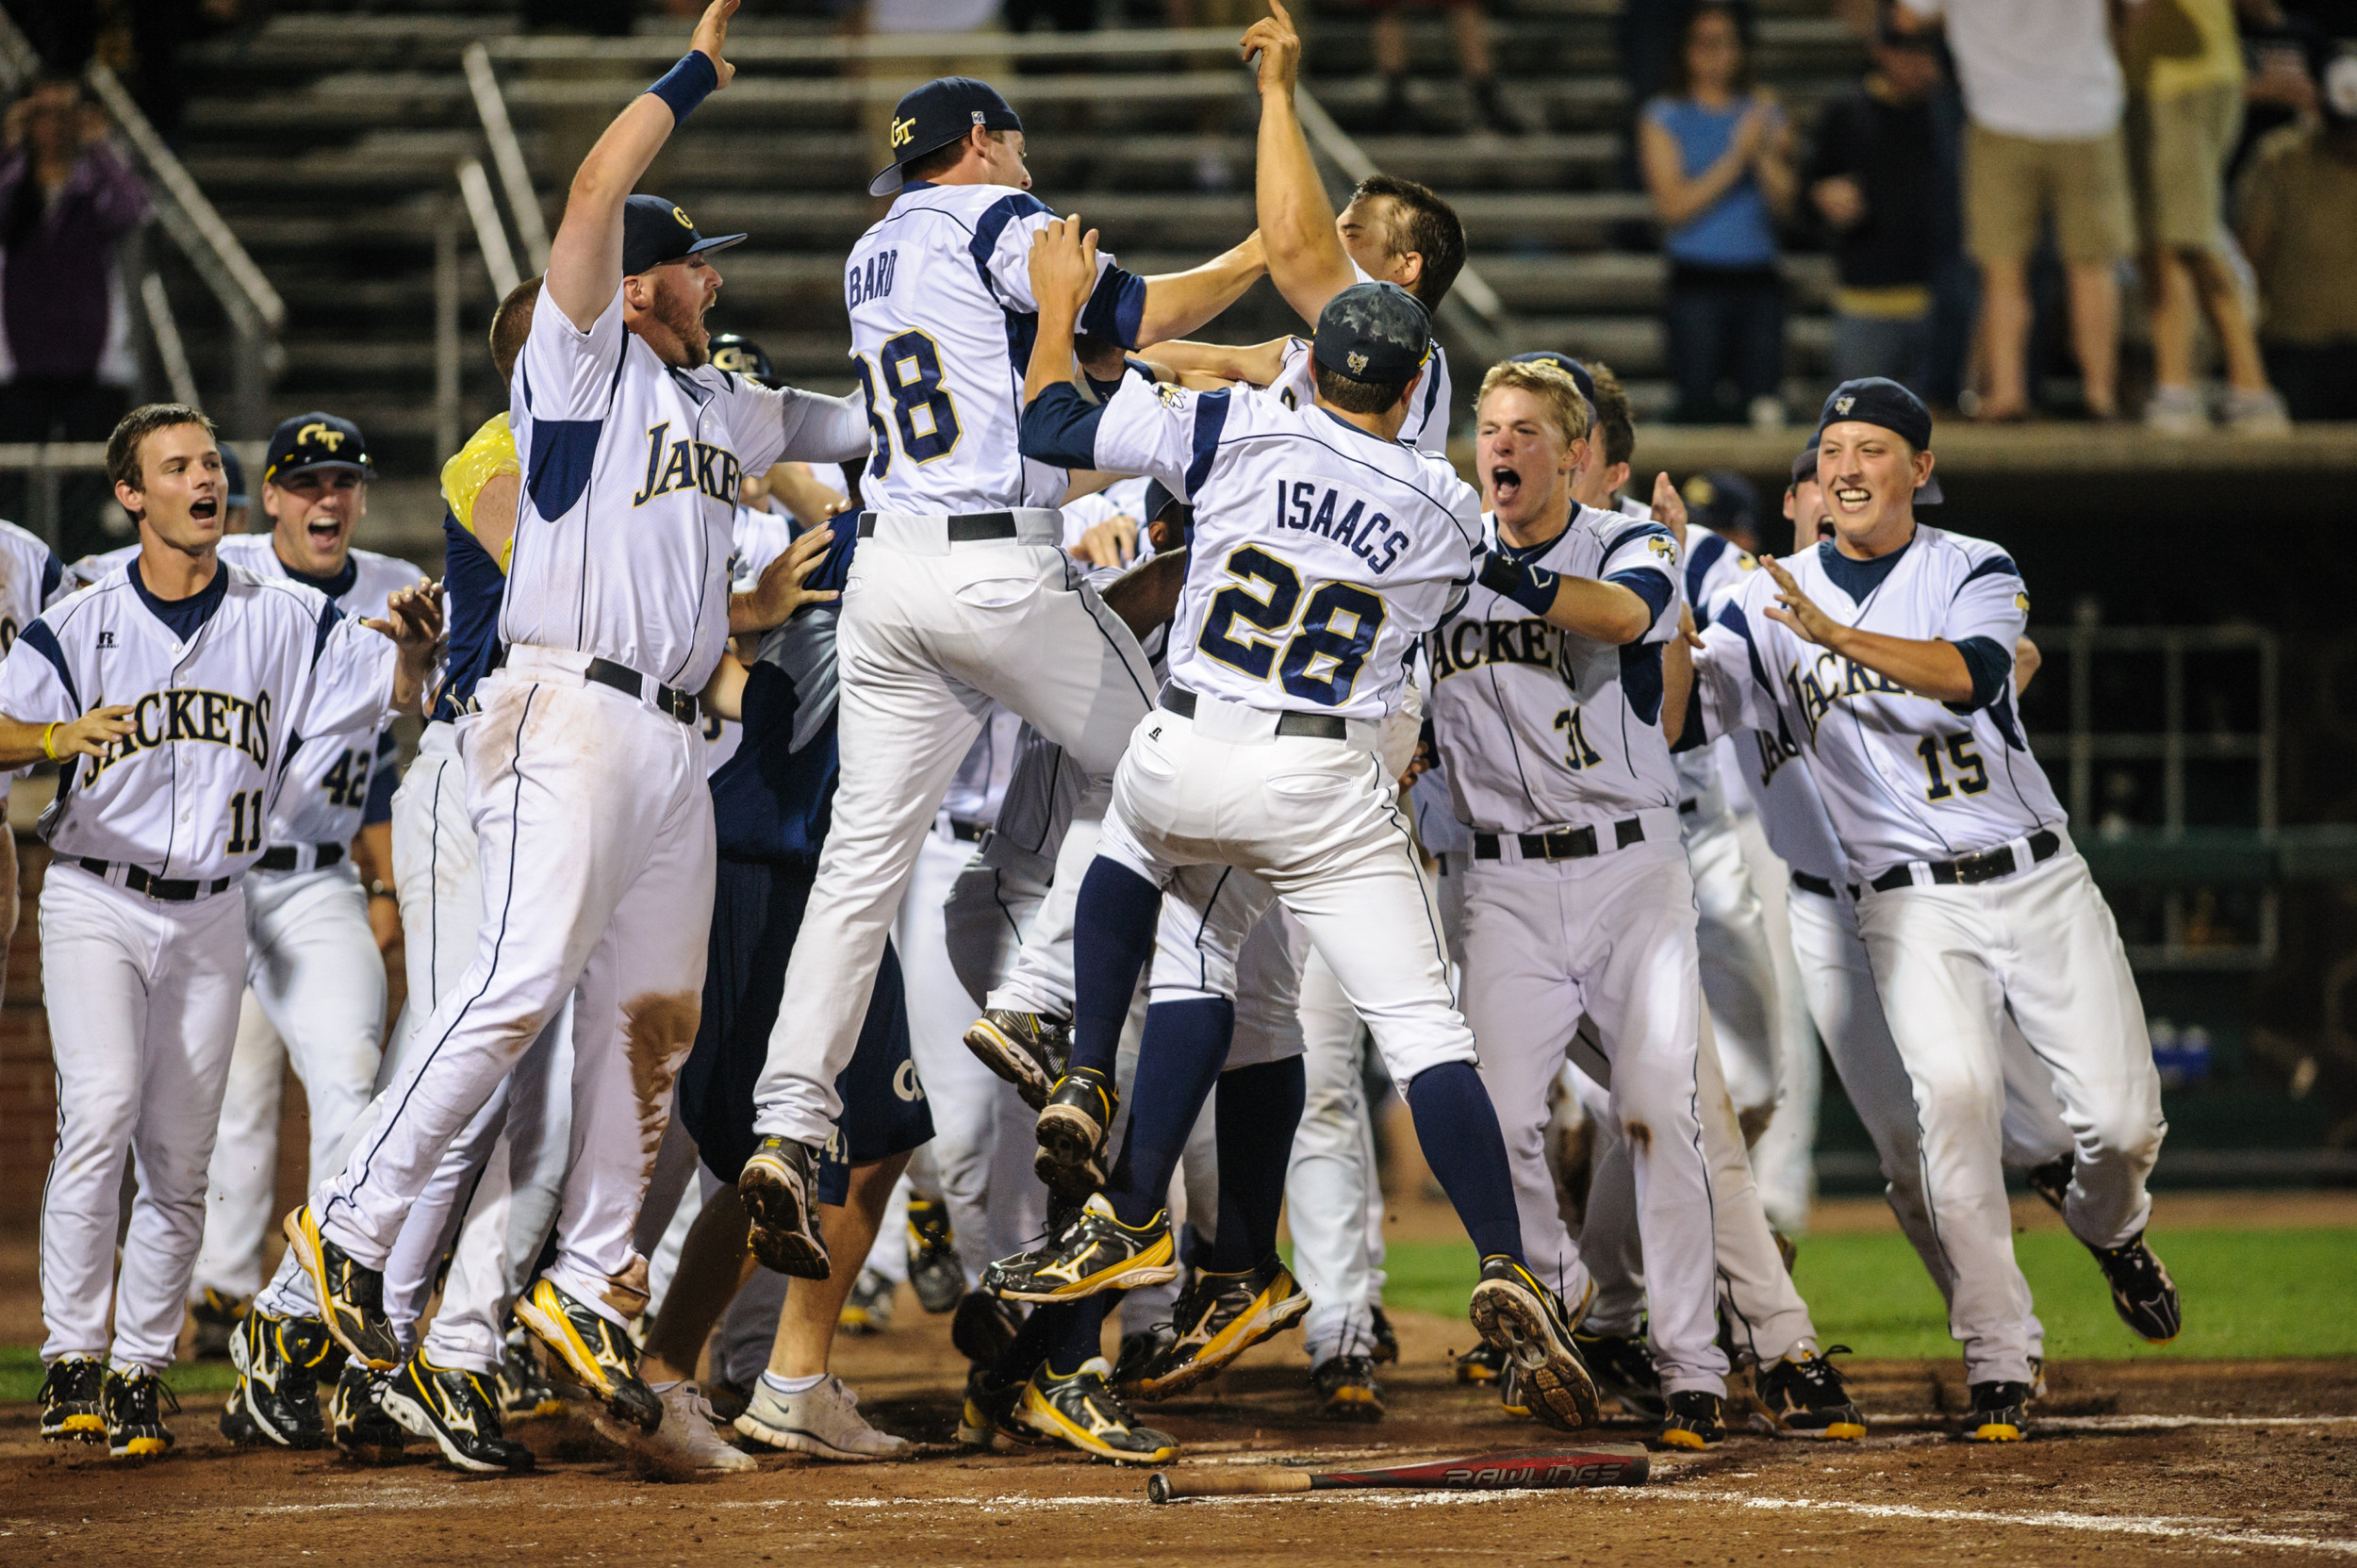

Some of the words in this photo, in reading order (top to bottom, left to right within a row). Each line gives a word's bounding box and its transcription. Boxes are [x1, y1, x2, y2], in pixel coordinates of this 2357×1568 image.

[891, 116, 916, 148] GT
[849, 249, 898, 311] BARD
[1277, 479, 1409, 575] ISAACS
[1196, 542, 1388, 708] 28
[320, 746, 371, 809] 42
[1915, 730, 1989, 801] 15
[226, 788, 264, 856] 11
[1443, 1462, 1624, 1487] RAWLINGS
